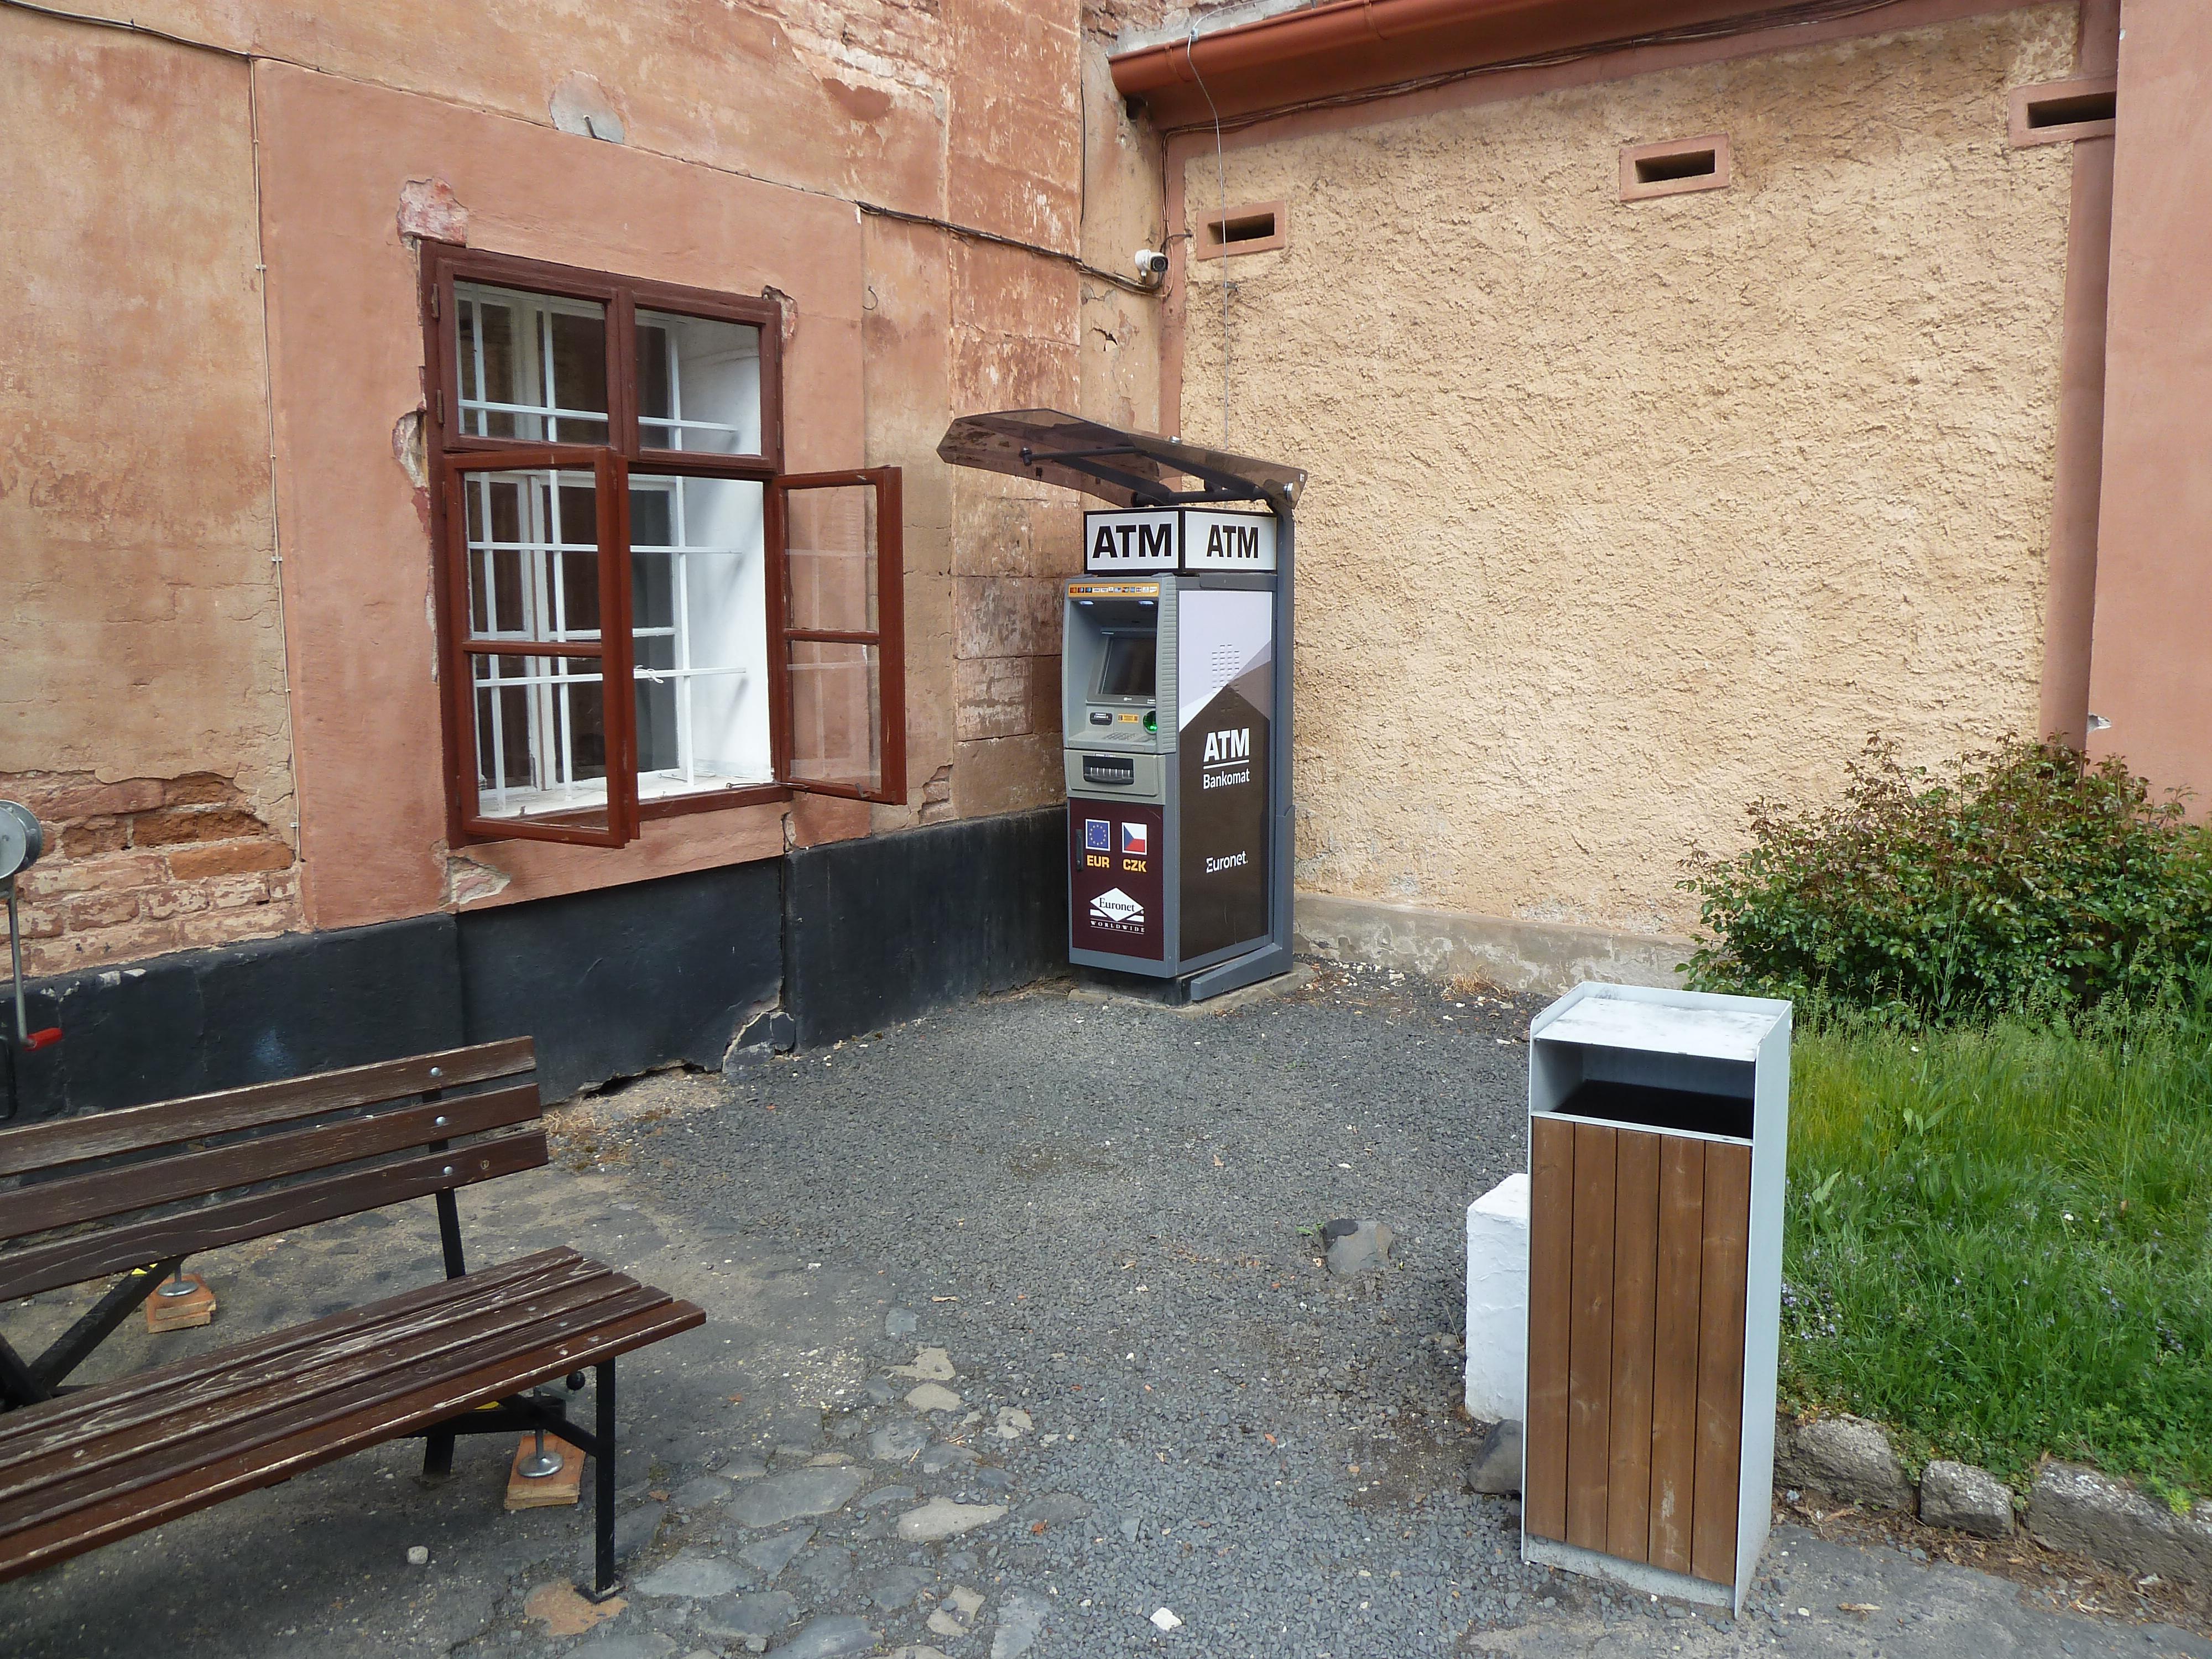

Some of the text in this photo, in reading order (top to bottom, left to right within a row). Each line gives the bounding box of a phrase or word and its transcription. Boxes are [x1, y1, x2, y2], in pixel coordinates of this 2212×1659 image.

[1092, 523, 1172, 559] ATM
[1206, 524, 1259, 559] ATM
[1203, 728, 1249, 762] ATM
[1203, 768, 1250, 789] Bankomat
[1087, 855, 1110, 868] EUR
[1123, 859, 1147, 872] CZK
[1206, 851, 1247, 873] Euronet
[1099, 898, 1135, 912] Euronet
[1091, 920, 1145, 932] WORLDWIDE
